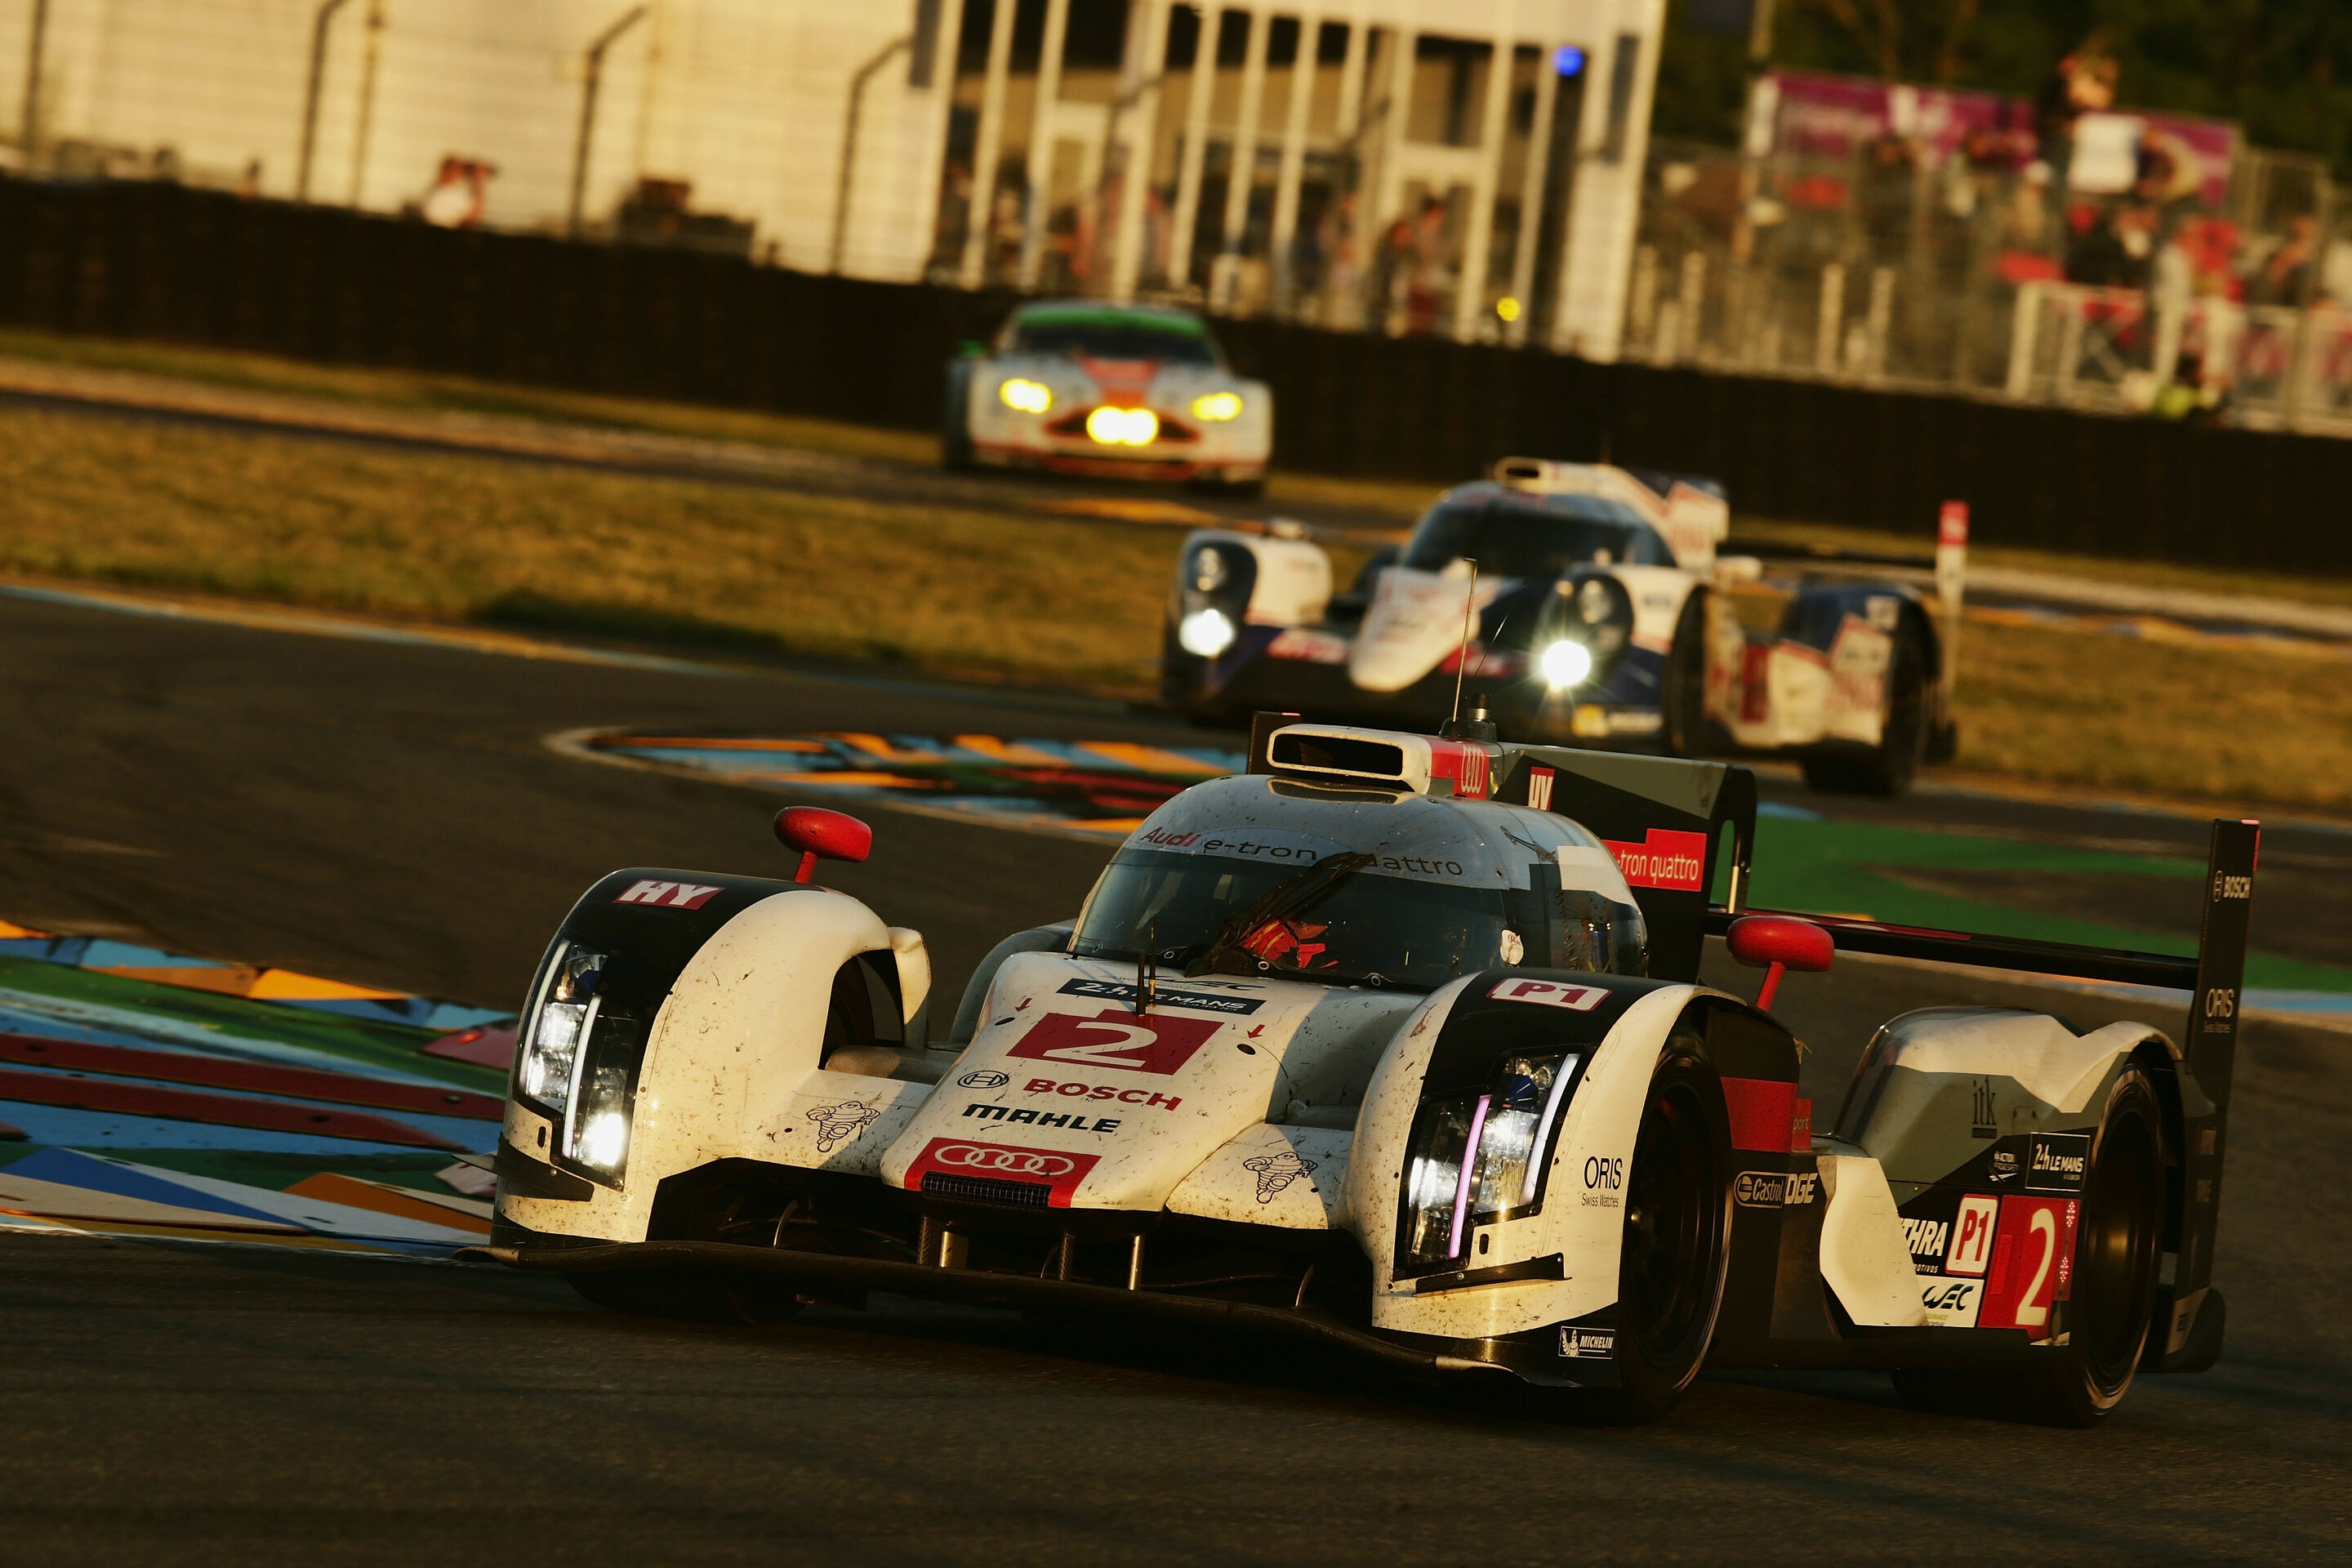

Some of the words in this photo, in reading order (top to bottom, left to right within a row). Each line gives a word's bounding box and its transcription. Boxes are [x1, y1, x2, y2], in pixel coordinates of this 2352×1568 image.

[1140, 826, 1201, 847] Audi
[1204, 840, 1316, 861] e-tron
[1361, 856, 1463, 876] uattro
[1617, 849, 1647, 876] -tron
[1650, 853, 1699, 885] quattro
[618, 880, 720, 906] HY
[2223, 875, 2252, 898] BOSCH
[1168, 995, 1247, 1009] MANS
[1509, 982, 1590, 1004] P1
[2206, 987, 2234, 1018] ORIS
[1042, 1021, 1157, 1068] 2
[1022, 1078, 1183, 1111] BOSCH
[962, 1103, 1122, 1134] MAHLE
[1584, 1156, 1623, 1190] ORIS
[2060, 1156, 2084, 1174] MANS
[1581, 1192, 1598, 1207] Swiss
[1599, 1194, 1619, 1208] Watches
[1753, 1178, 1784, 1202] Castrol
[1955, 1209, 1990, 1262] P1
[2014, 1207, 2056, 1326] 2
[1922, 1282, 1975, 1312] WEC
[1579, 1334, 1615, 1349] MICHELIN
